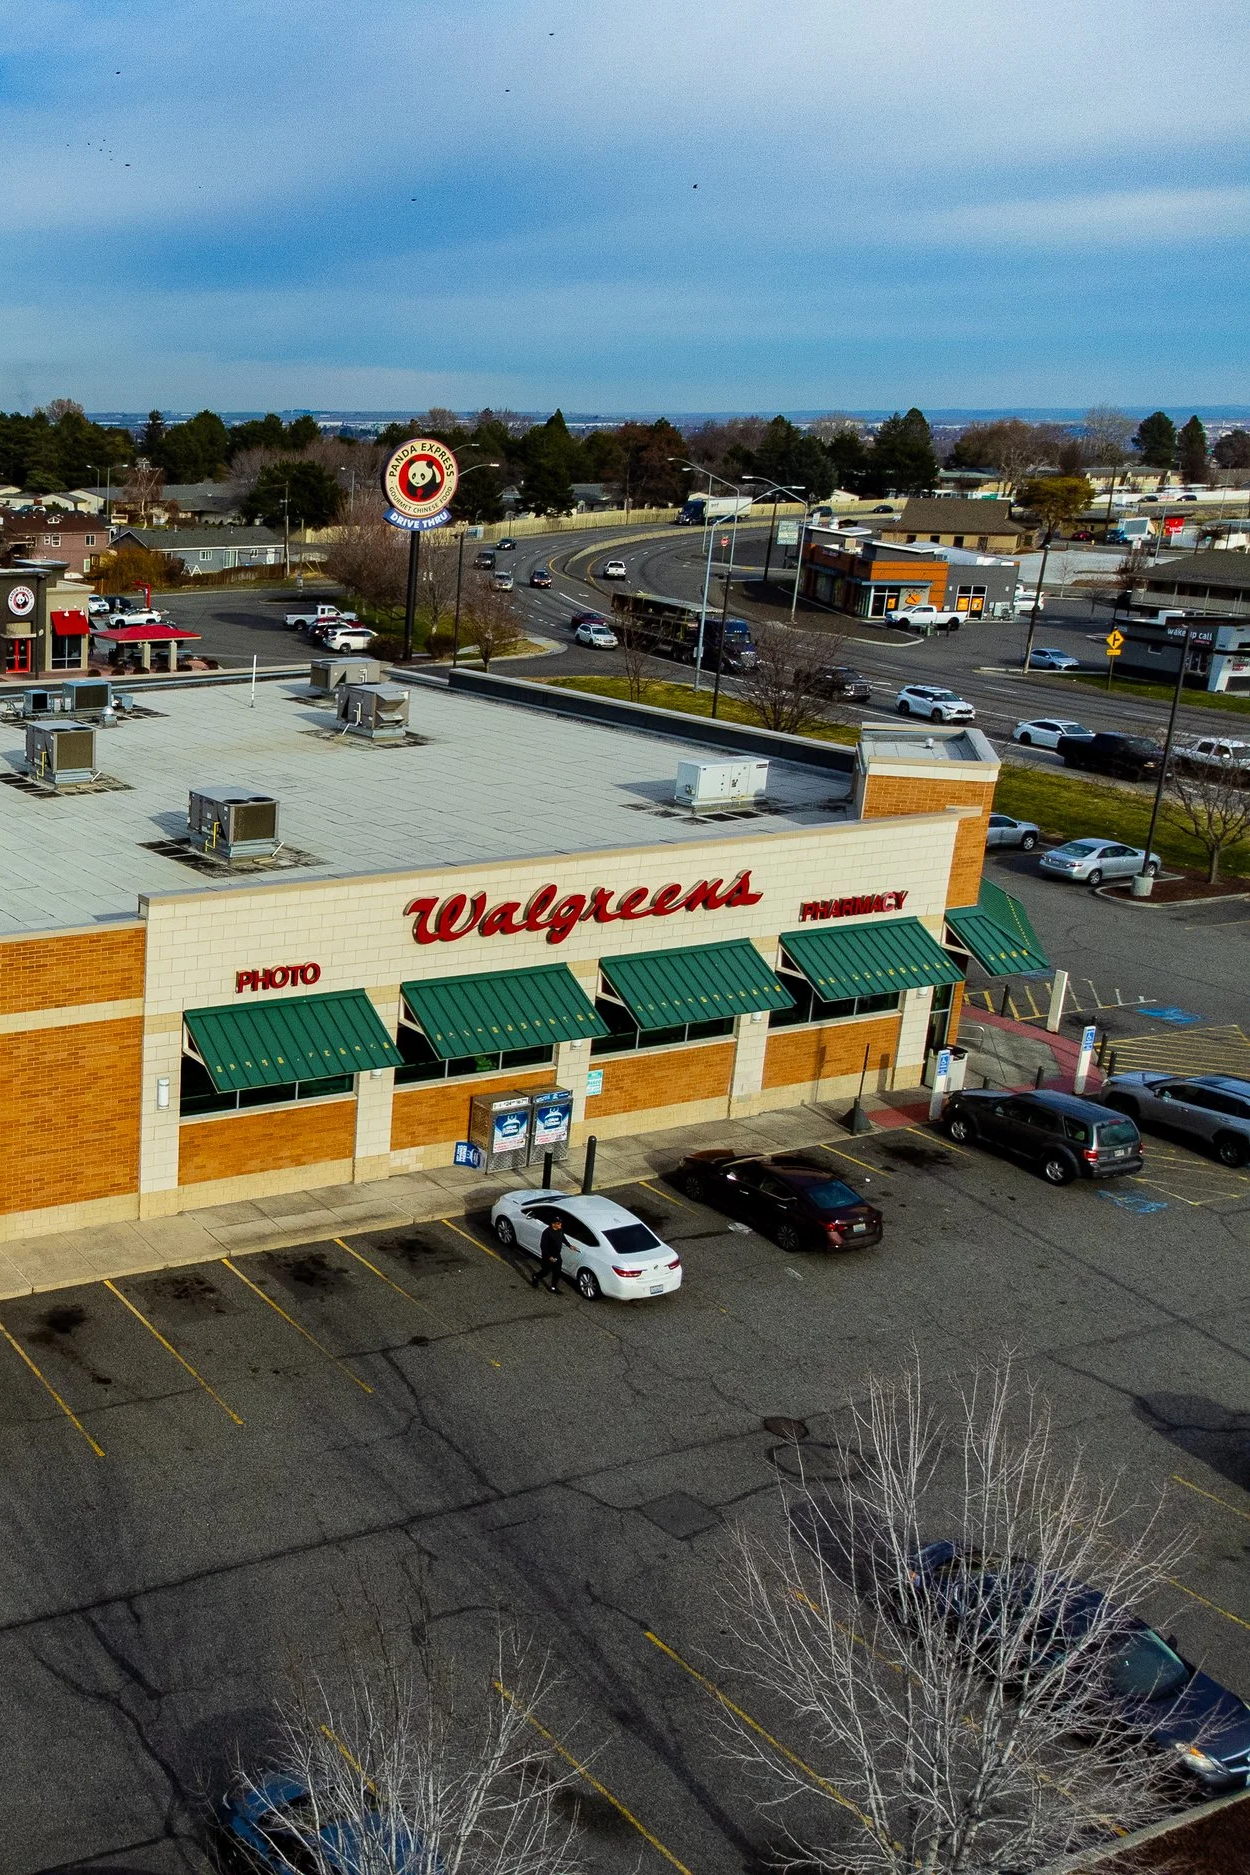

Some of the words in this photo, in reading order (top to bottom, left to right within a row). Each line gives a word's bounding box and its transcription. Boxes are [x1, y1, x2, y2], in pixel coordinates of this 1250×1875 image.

[389, 445, 417, 477] PANDA
[421, 443, 454, 477] EXPRESS
[389, 486, 411, 511] GOURMET
[413, 504, 439, 513] CHINESE
[440, 486, 453, 503] FOOD
[390, 512, 420, 528] DRIVE
[422, 511, 448, 527] THRU
[1167, 628, 1186, 637] wake
[1198, 632, 1213, 641] call
[404, 869, 764, 945] Walgreens
[798, 890, 909, 922] PHARMACY
[235, 961, 321, 993] PHOTO
